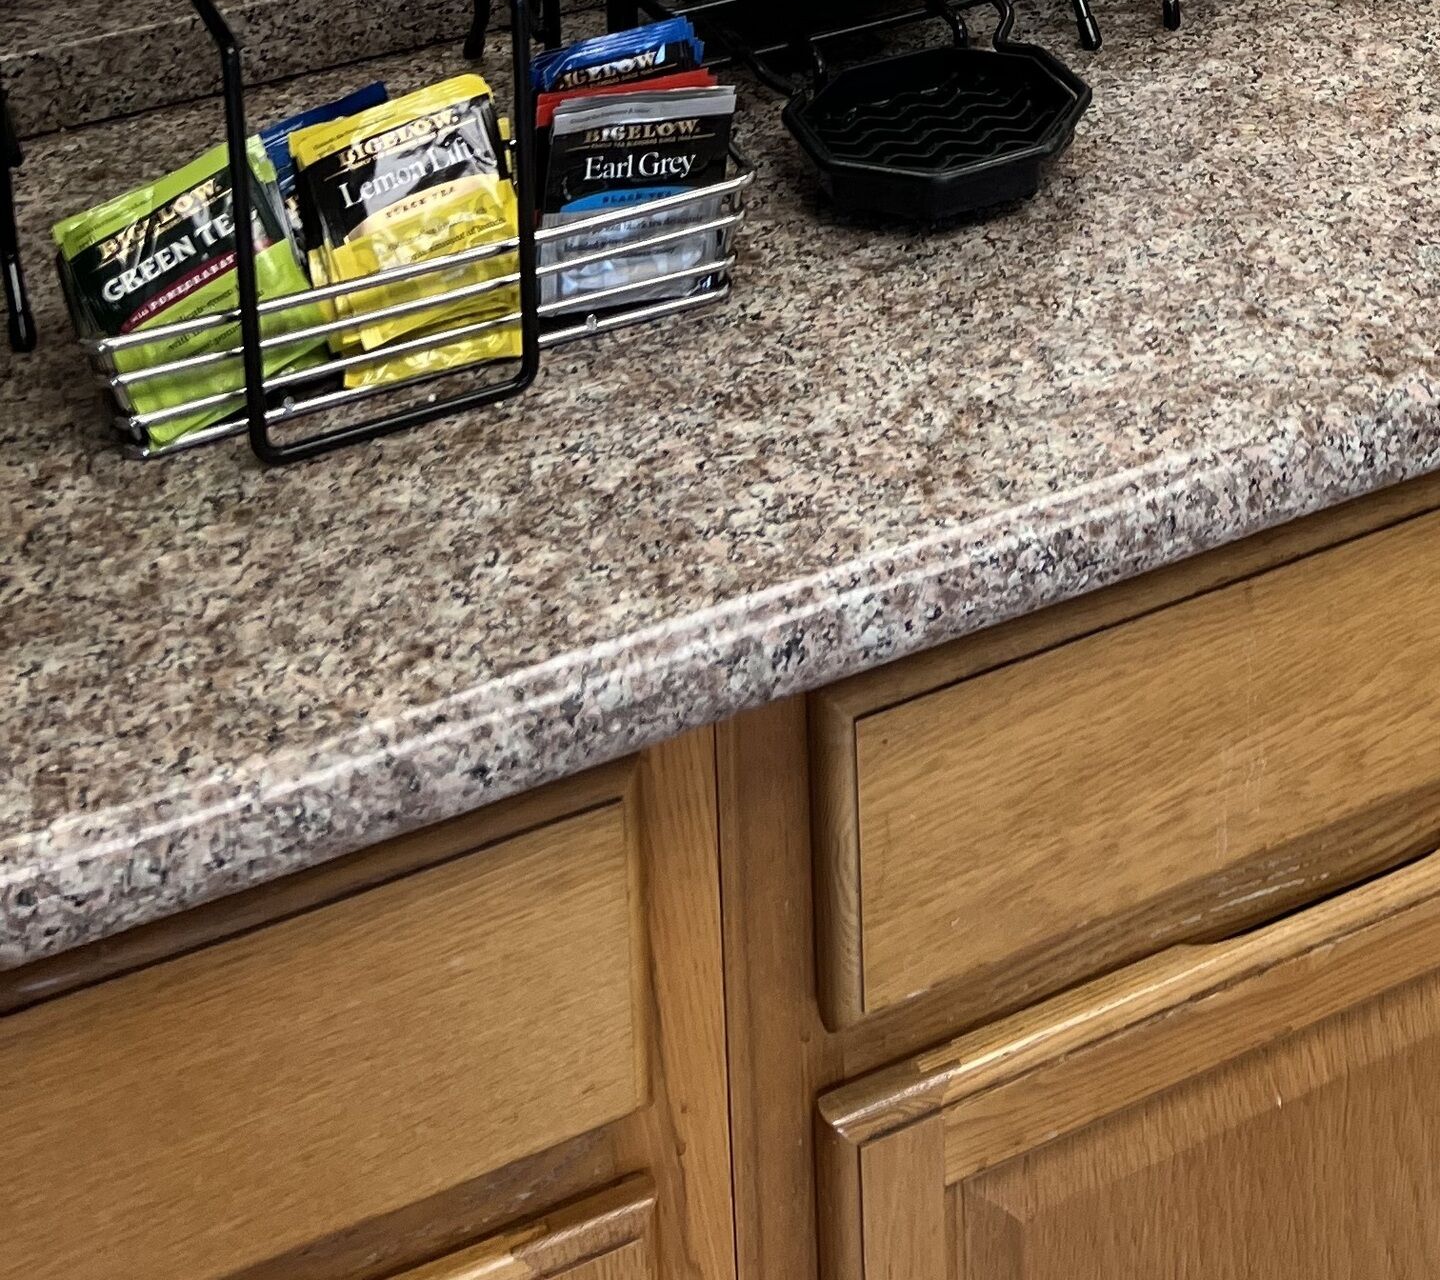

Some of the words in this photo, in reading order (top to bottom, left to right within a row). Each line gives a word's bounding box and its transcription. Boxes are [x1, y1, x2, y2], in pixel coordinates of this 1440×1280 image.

[560, 50, 658, 89] IGELOW
[585, 119, 701, 143] BIGELOW
[338, 158, 427, 209] Lemon
[583, 153, 634, 181] Earl
[638, 151, 697, 178] Grey
[102, 235, 197, 304] GREEN
[150, 252, 238, 310] POMEGRANAT
